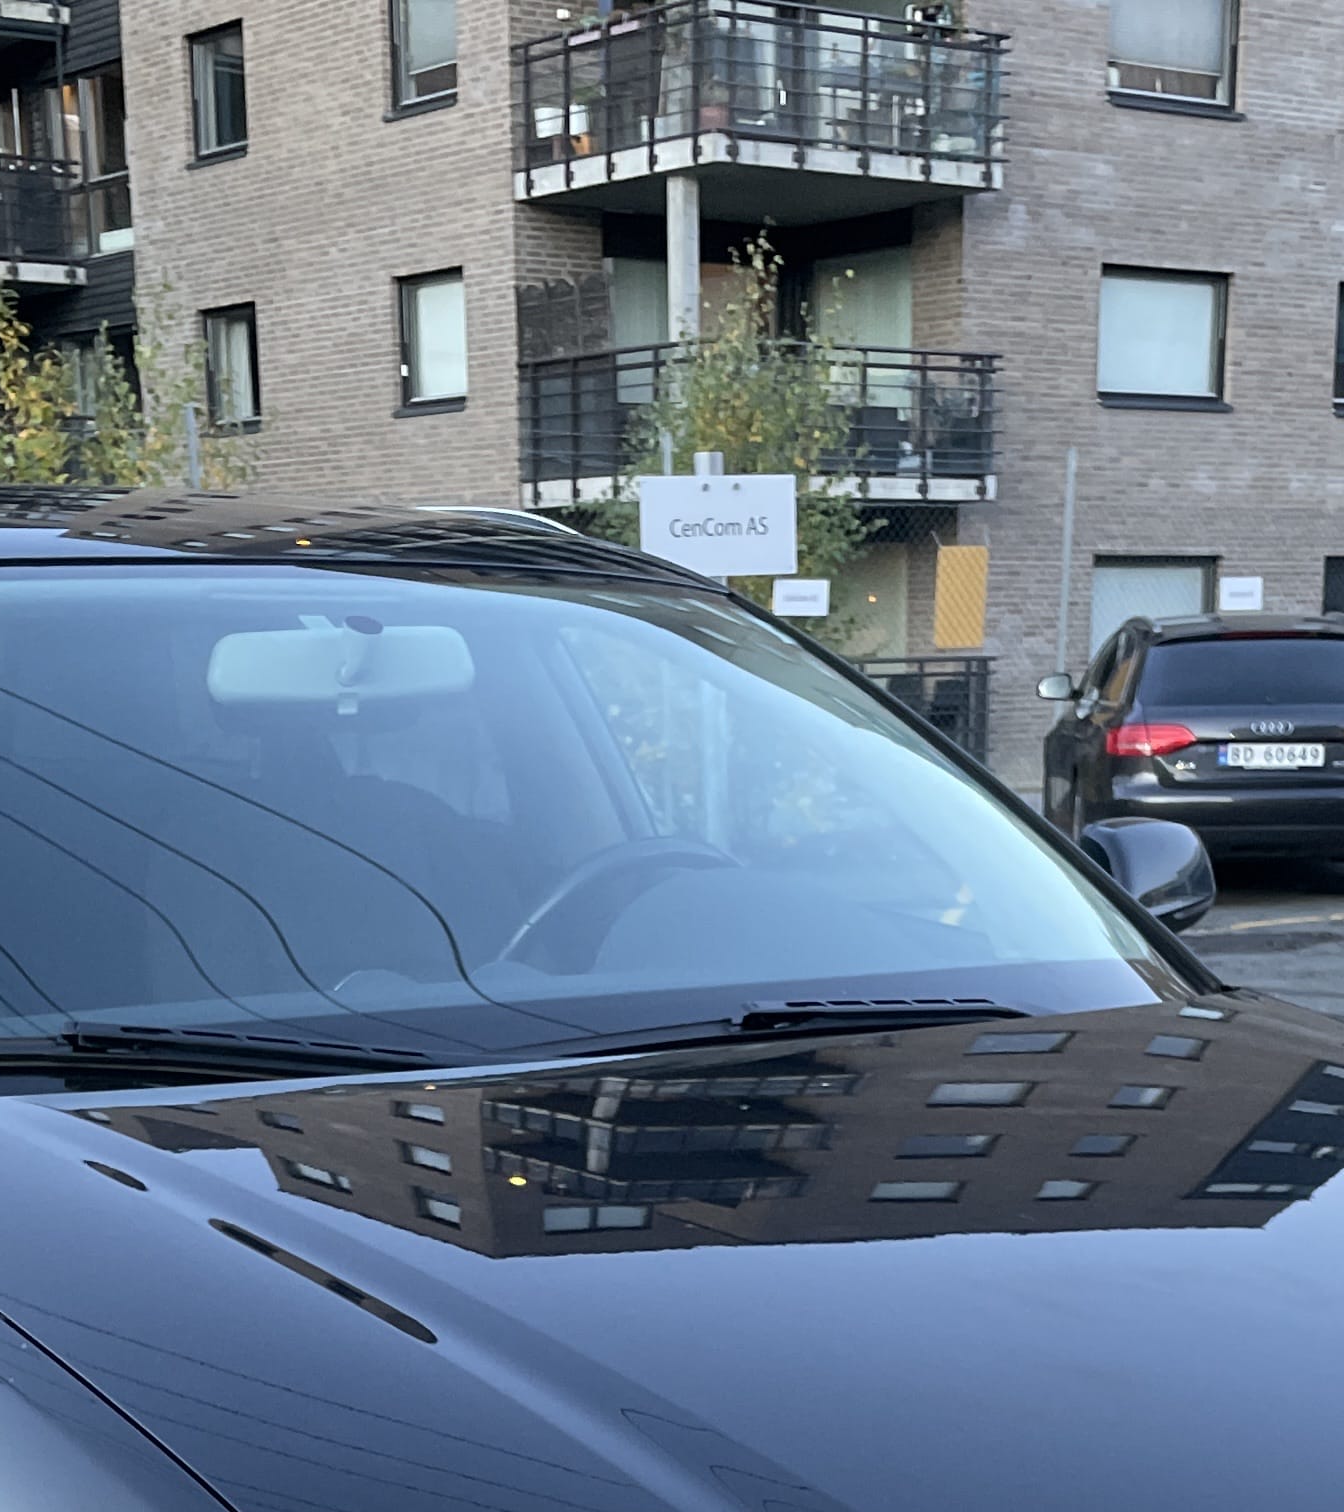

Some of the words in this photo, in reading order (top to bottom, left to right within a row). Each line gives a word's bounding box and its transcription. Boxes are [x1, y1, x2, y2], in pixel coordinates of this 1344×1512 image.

[668, 517, 743, 538] CenCom
[746, 515, 770, 536] AS
[1263, 745, 1321, 763] 60649
